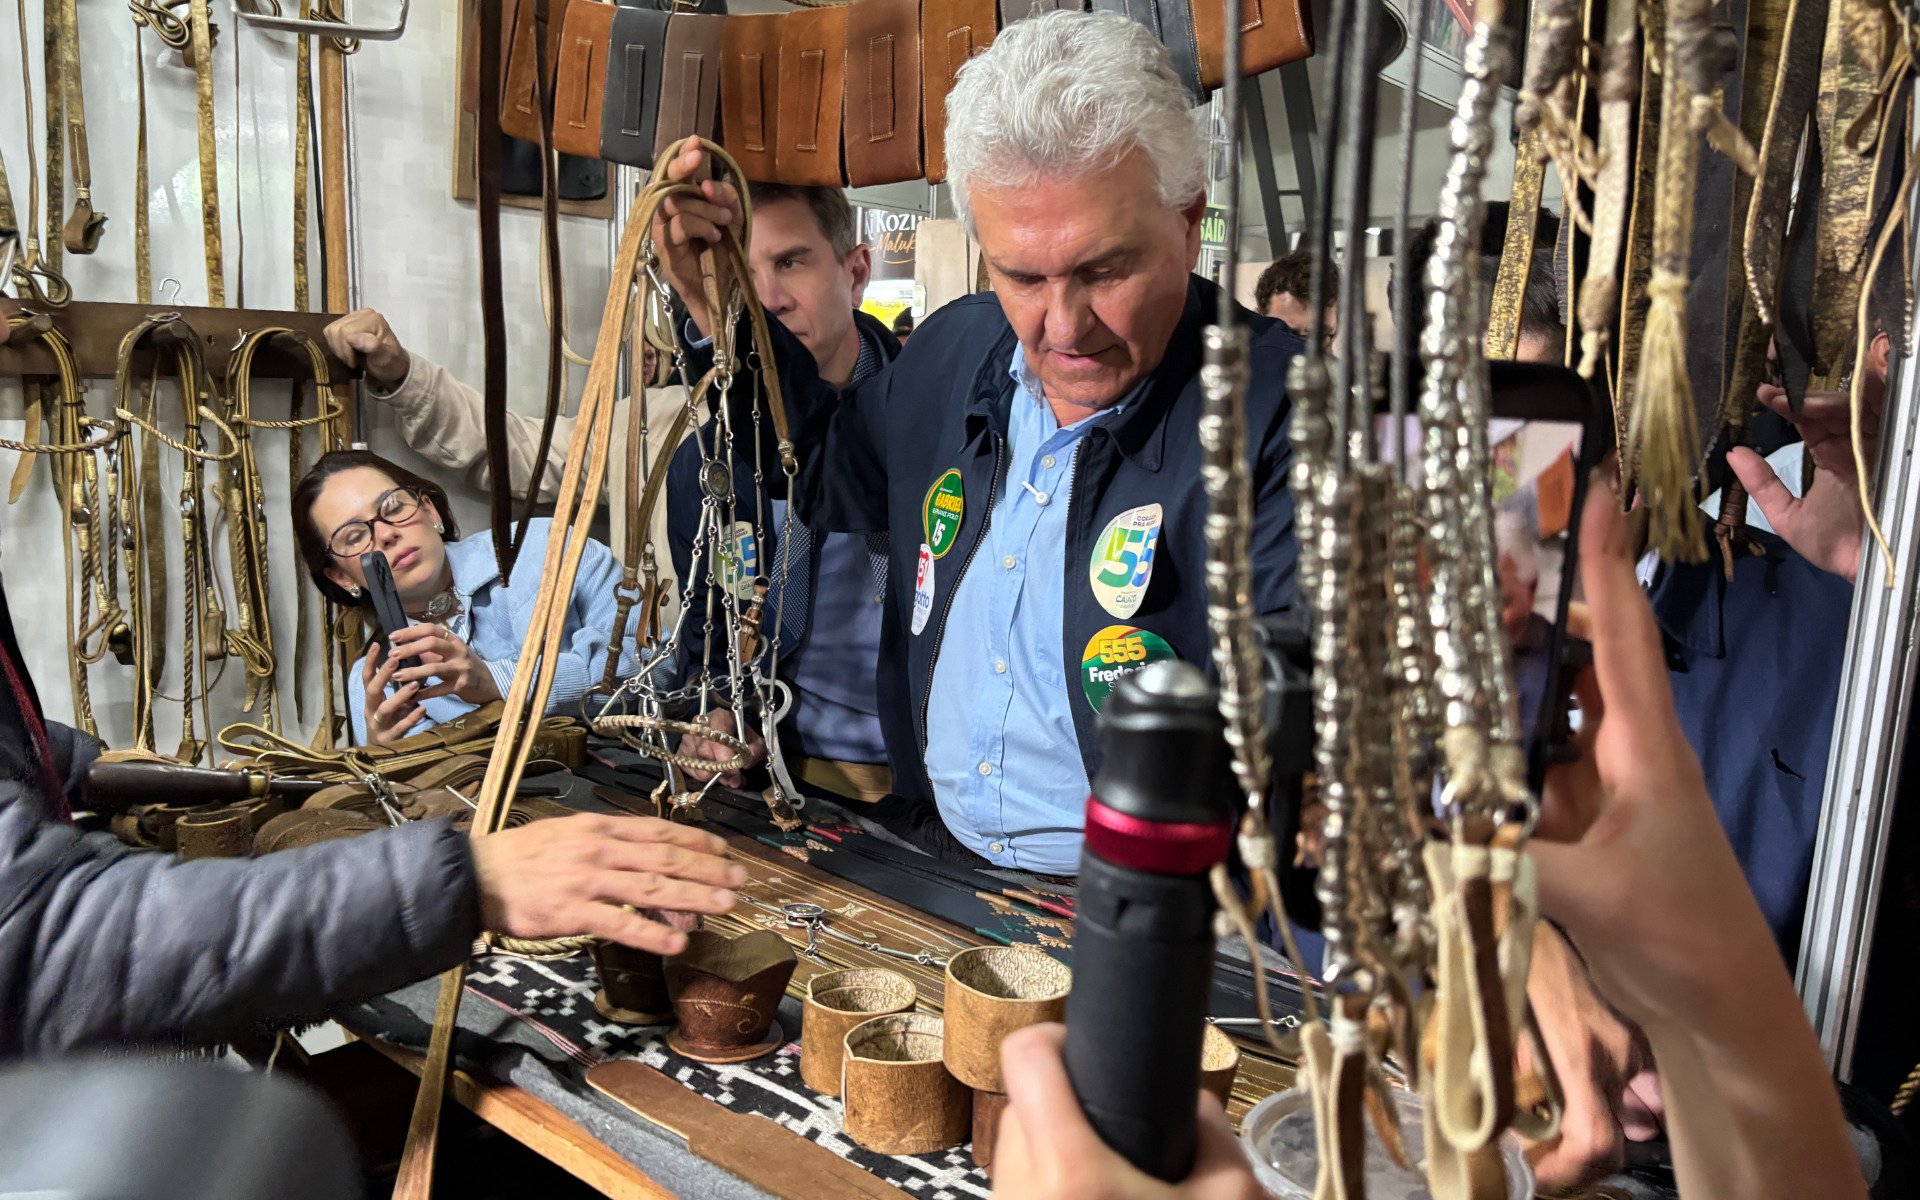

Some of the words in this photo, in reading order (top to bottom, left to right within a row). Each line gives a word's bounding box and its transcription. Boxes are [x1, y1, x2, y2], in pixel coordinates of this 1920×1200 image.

[876, 210, 928, 233] KOZI
[1200, 211, 1229, 243] SAÍD
[876, 232, 916, 258] Maluk
[932, 518, 946, 547] 15
[1099, 636, 1147, 664] 555
